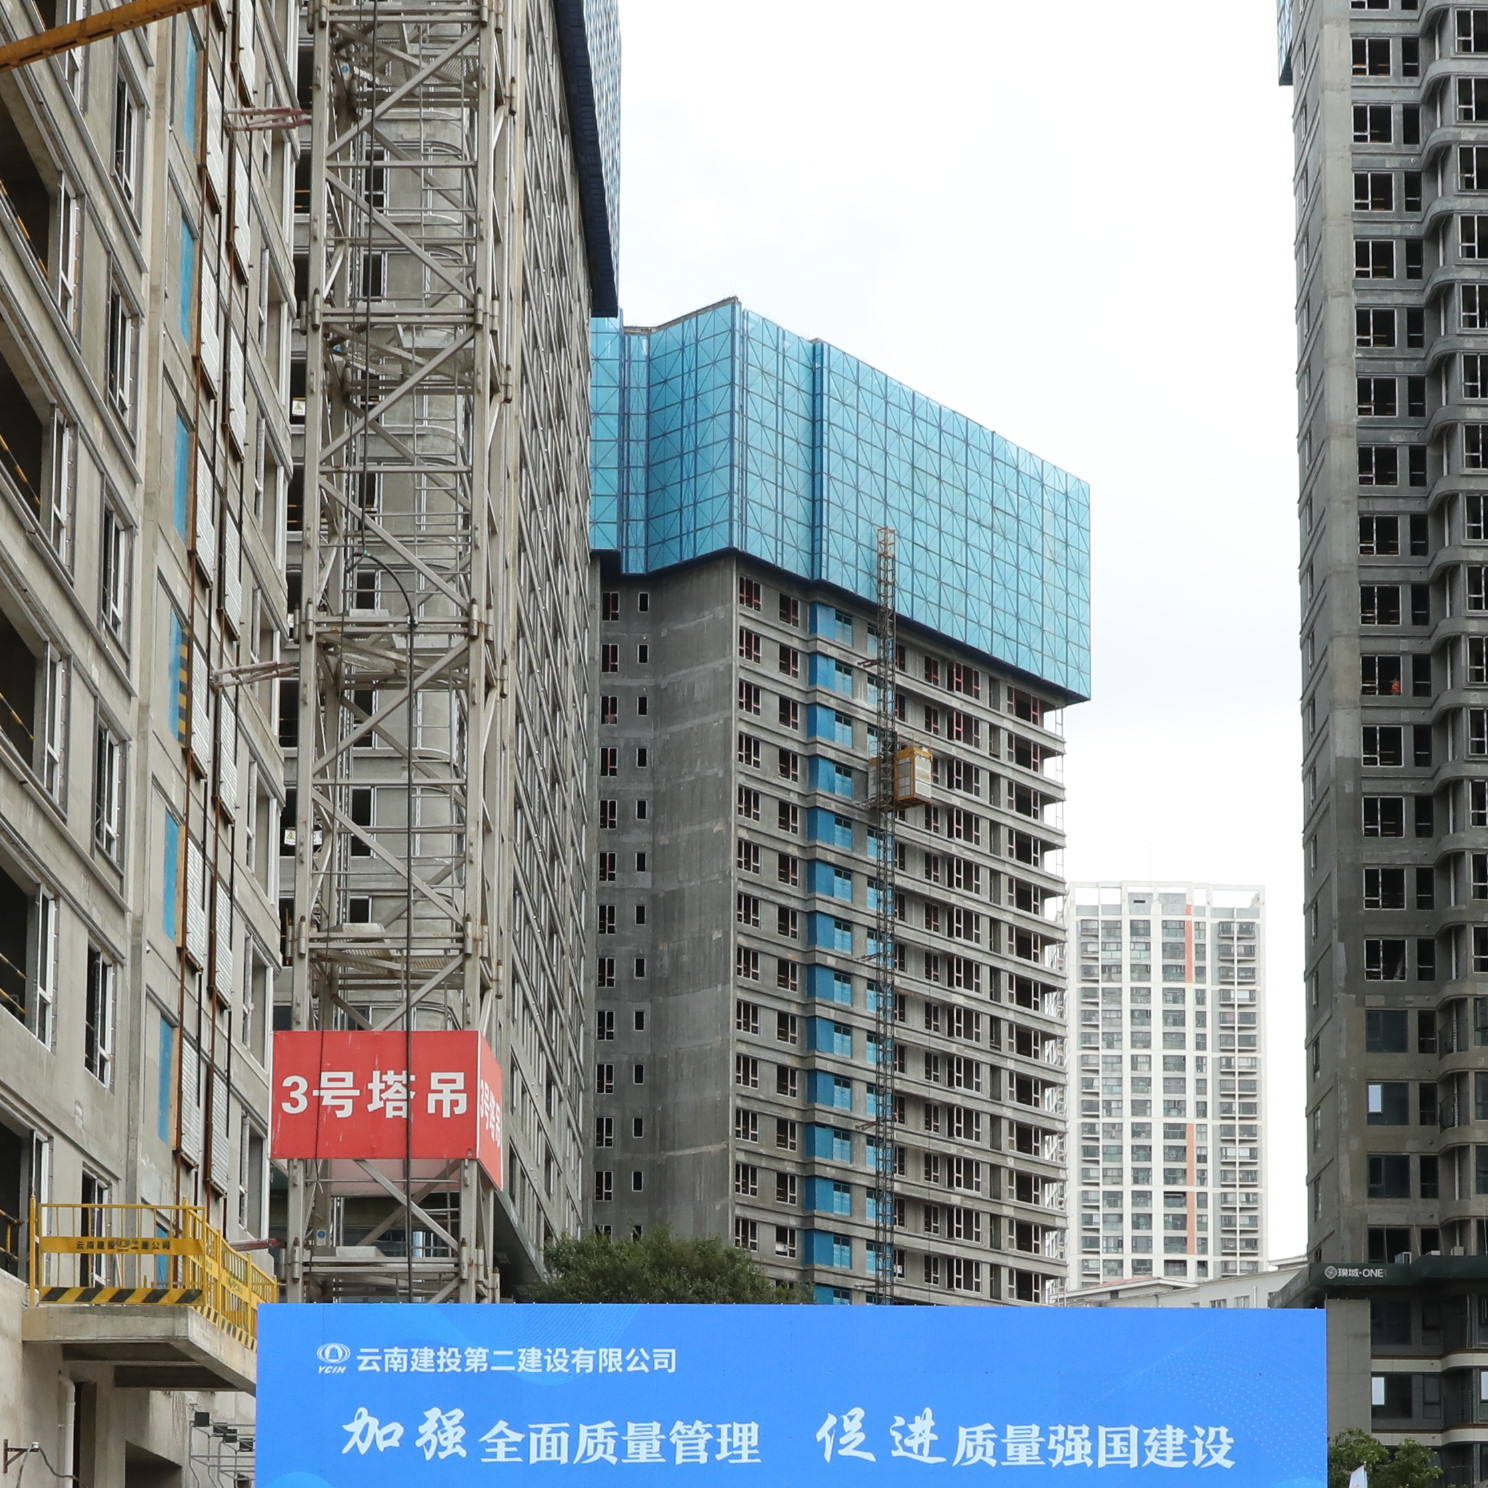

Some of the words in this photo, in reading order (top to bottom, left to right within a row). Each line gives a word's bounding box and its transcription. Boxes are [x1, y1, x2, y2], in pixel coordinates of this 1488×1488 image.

[281, 1069, 468, 1119] 3号塔吊
[356, 1345, 678, 1375] 云南建投第二建设有限公司
[341, 1406, 762, 1466] 加强全面质量管理
[815, 1406, 1236, 1469] 促进质量强国建设
